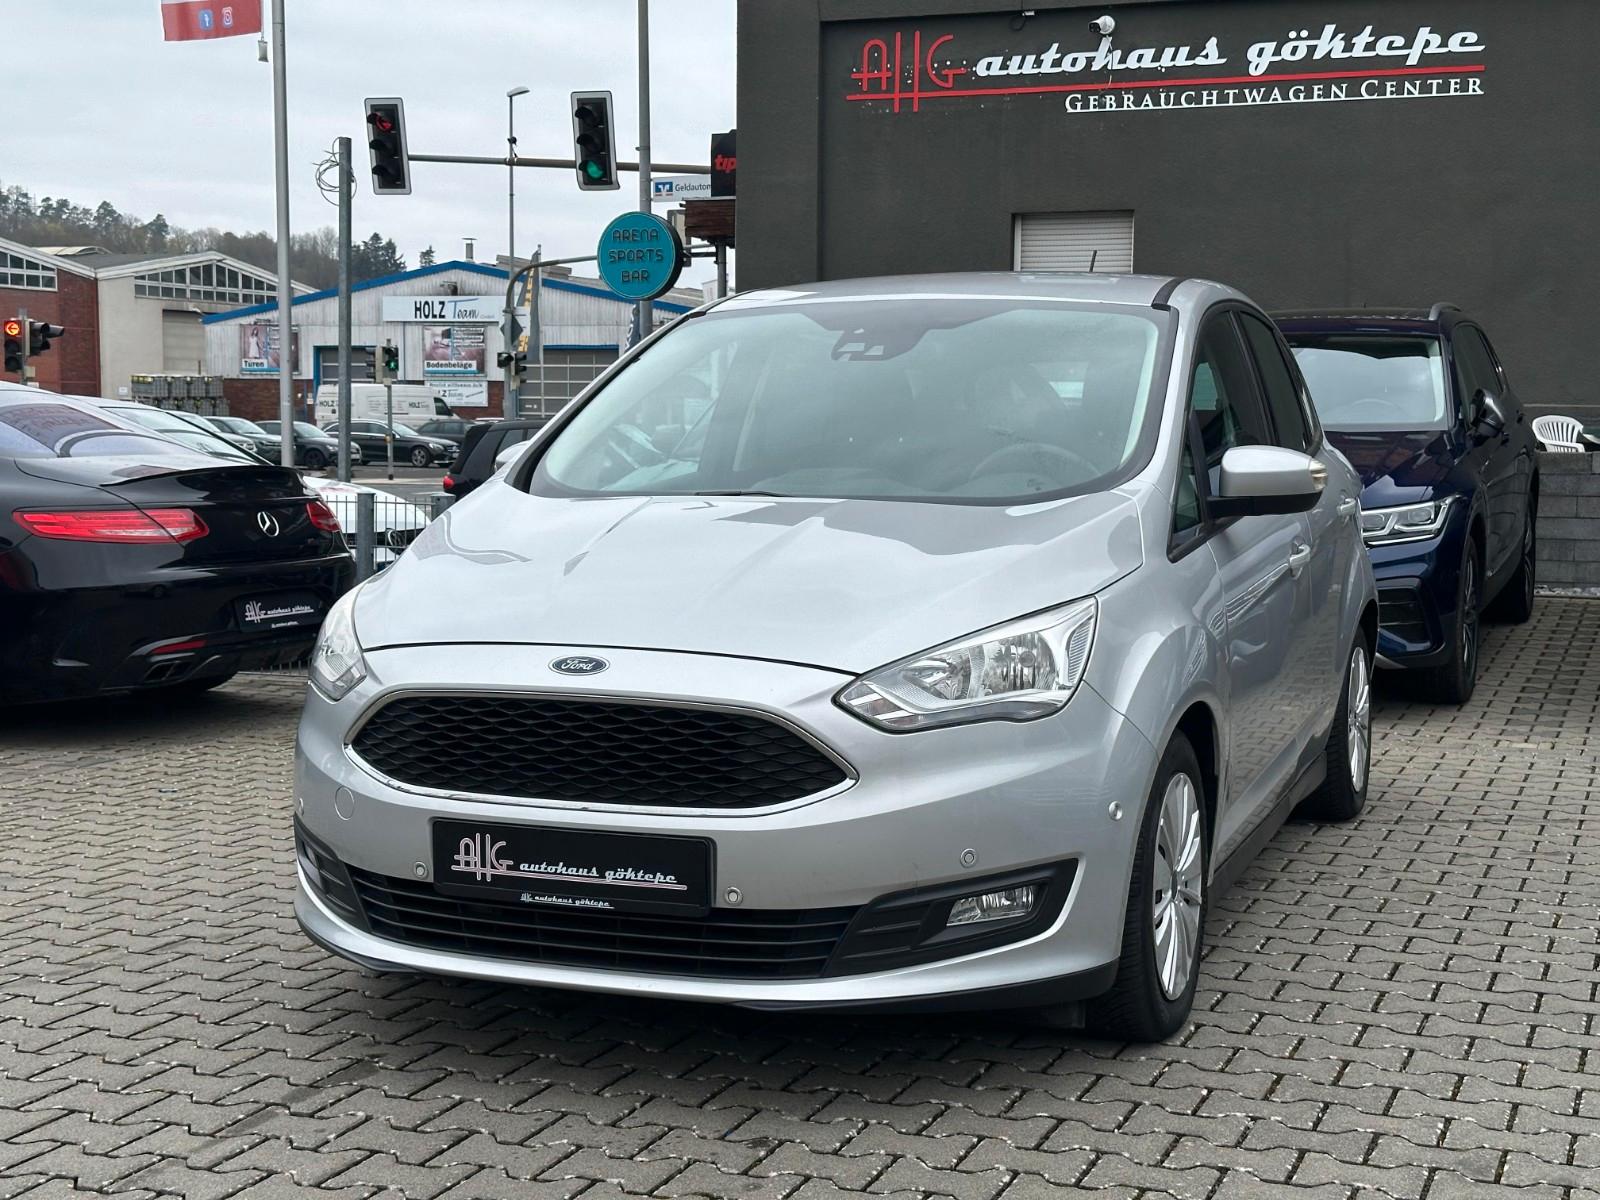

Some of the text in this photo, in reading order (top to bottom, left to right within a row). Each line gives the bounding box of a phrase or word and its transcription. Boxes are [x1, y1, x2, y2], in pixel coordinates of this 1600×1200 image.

[975, 36, 1227, 77] autohaus
[1247, 23, 1486, 76] göktepe
[1360, 77, 1485, 98] CENTER
[612, 229, 660, 242] ARENA
[608, 250, 665, 263] SPORTS
[621, 270, 650, 283] BAR
[414, 298, 480, 319] HOLZ Team
[319, 400, 335, 408] HOLZ
[561, 659, 597, 670] Ford
[519, 861, 600, 878] autohaus
[604, 867, 678, 883] göktepe
[534, 895, 573, 904] autohaus
